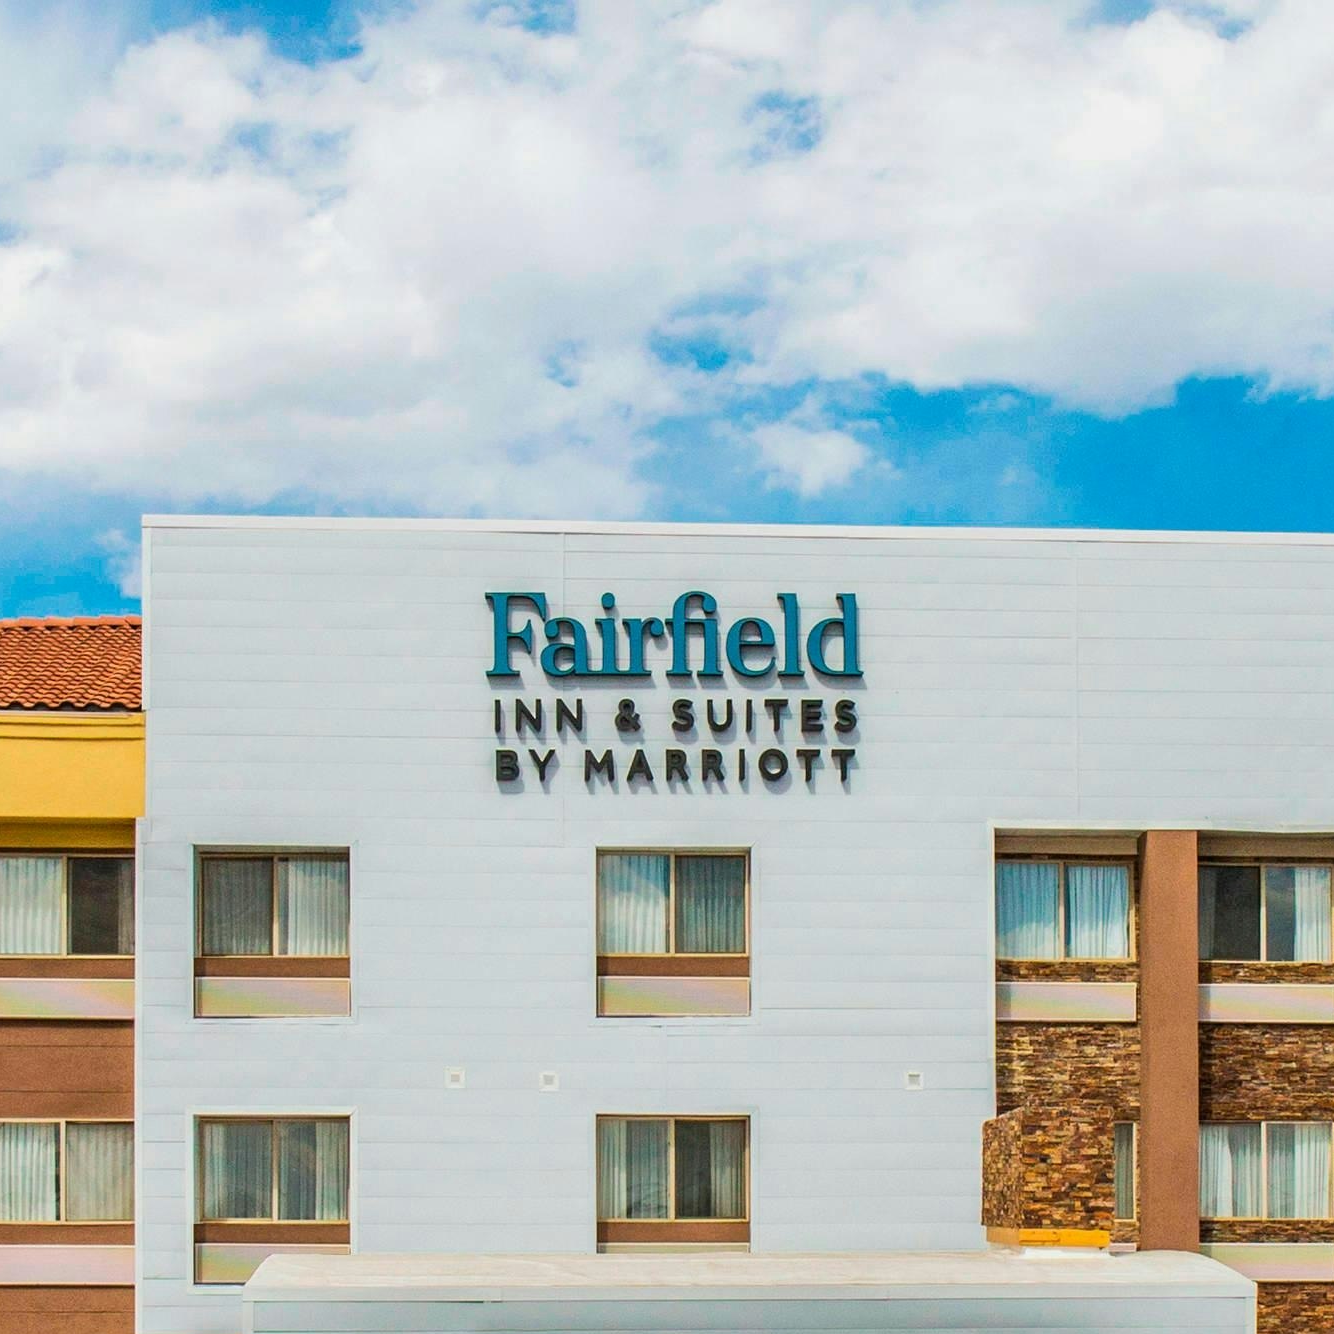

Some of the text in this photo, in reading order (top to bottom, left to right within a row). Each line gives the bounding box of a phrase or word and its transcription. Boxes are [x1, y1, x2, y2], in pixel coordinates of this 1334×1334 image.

[485, 590, 864, 678] Fairfield
[493, 698, 858, 733] INN & SUITES
[495, 749, 857, 783] BY MARRIOTT
